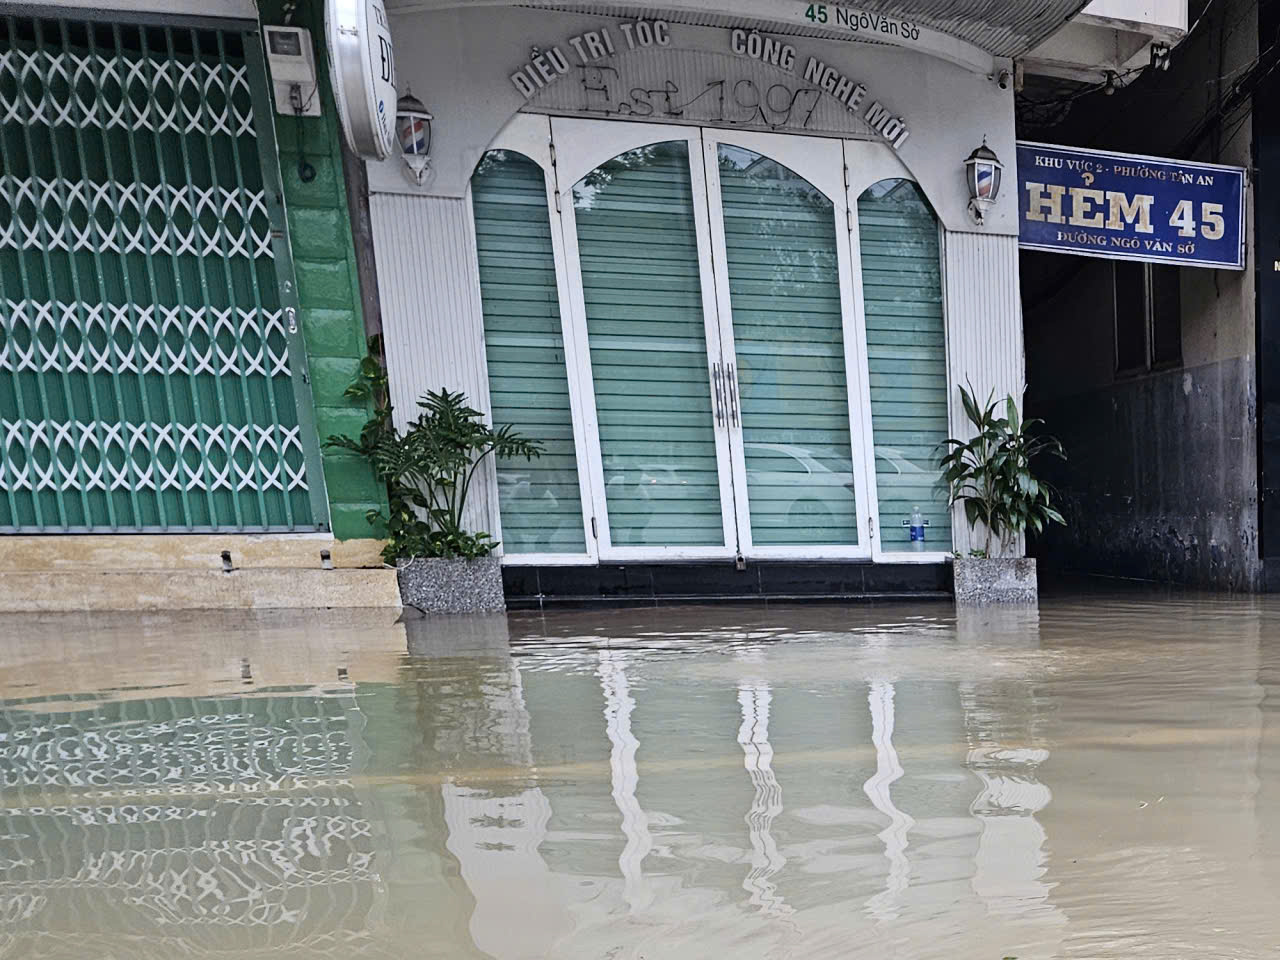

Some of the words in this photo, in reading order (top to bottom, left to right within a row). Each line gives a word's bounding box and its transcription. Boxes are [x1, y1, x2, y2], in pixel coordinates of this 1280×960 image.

[805, 4, 828, 23] 45
[511, 47, 570, 100] ĐIỀU
[569, 28, 615, 63] TRỊ
[620, 17, 670, 50] TÓC
[731, 28, 797, 71] CÔNG
[803, 56, 867, 112] NGHỆ
[864, 100, 910, 150] MỚI
[1035, 156, 1063, 168] KHU
[1066, 159, 1093, 173] VỰC
[1096, 162, 1103, 173] 2
[1114, 165, 1166, 181] PHƯỜNG
[1169, 170, 1194, 185] TÂN
[1196, 175, 1214, 186] AN
[1025, 172, 1154, 234] HẺM
[1169, 199, 1225, 241] 45
[1056, 230, 1107, 246] ĐƯỜNG
[1111, 235, 1140, 249] NGÔ
[1144, 237, 1173, 253] VĂN
[1177, 241, 1195, 255] SỞ
